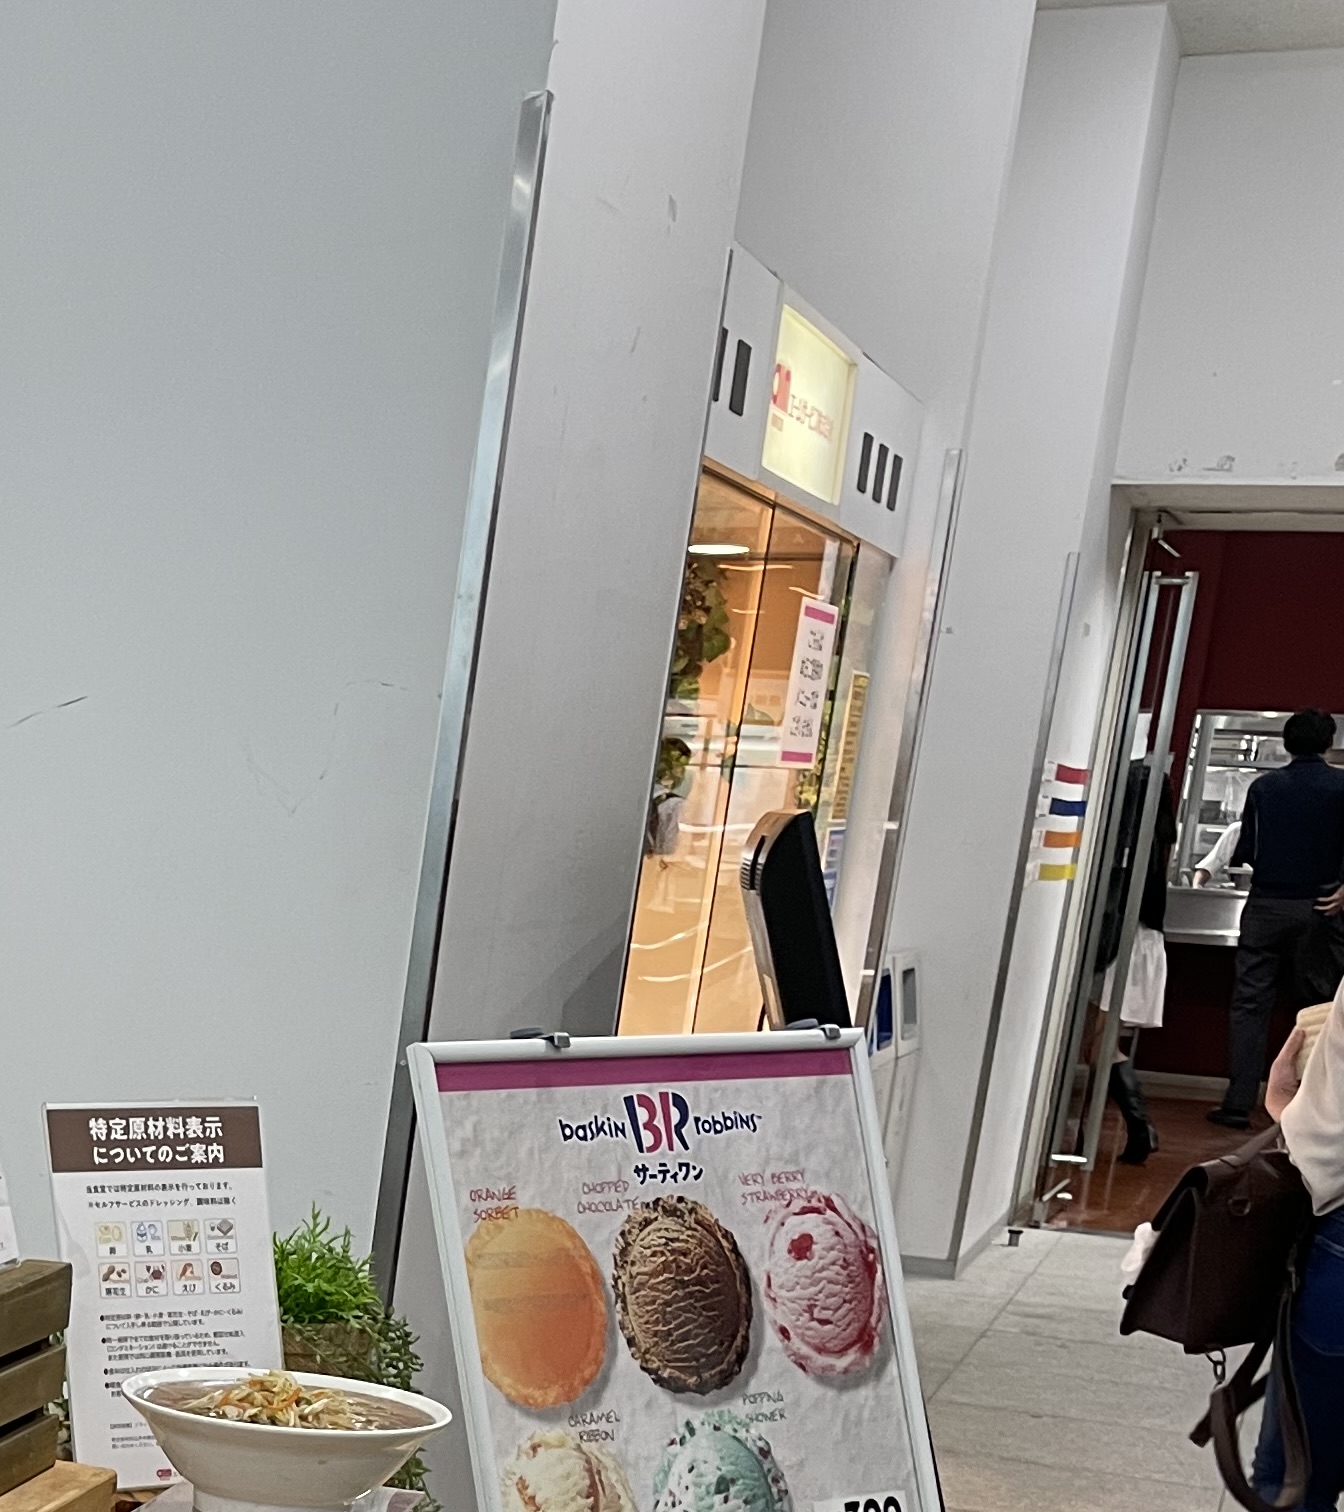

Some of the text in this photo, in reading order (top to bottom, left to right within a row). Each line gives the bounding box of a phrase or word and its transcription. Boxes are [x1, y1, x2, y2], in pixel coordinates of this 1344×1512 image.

[88, 1115, 224, 1142] 特定原材料表示
[558, 1115, 627, 1143] baskin
[693, 1111, 758, 1136] robbins
[92, 1142, 225, 1165] についてのご案内
[633, 1161, 705, 1185] サーティワン
[738, 1167, 806, 1187] VERY BERRY
[469, 1185, 518, 1203] ORANGE
[581, 1179, 630, 1195] CHOPPED
[473, 1206, 520, 1223] SORBET
[576, 1196, 640, 1214] CHOCOLATE
[567, 1409, 621, 1428] CARAMEL
